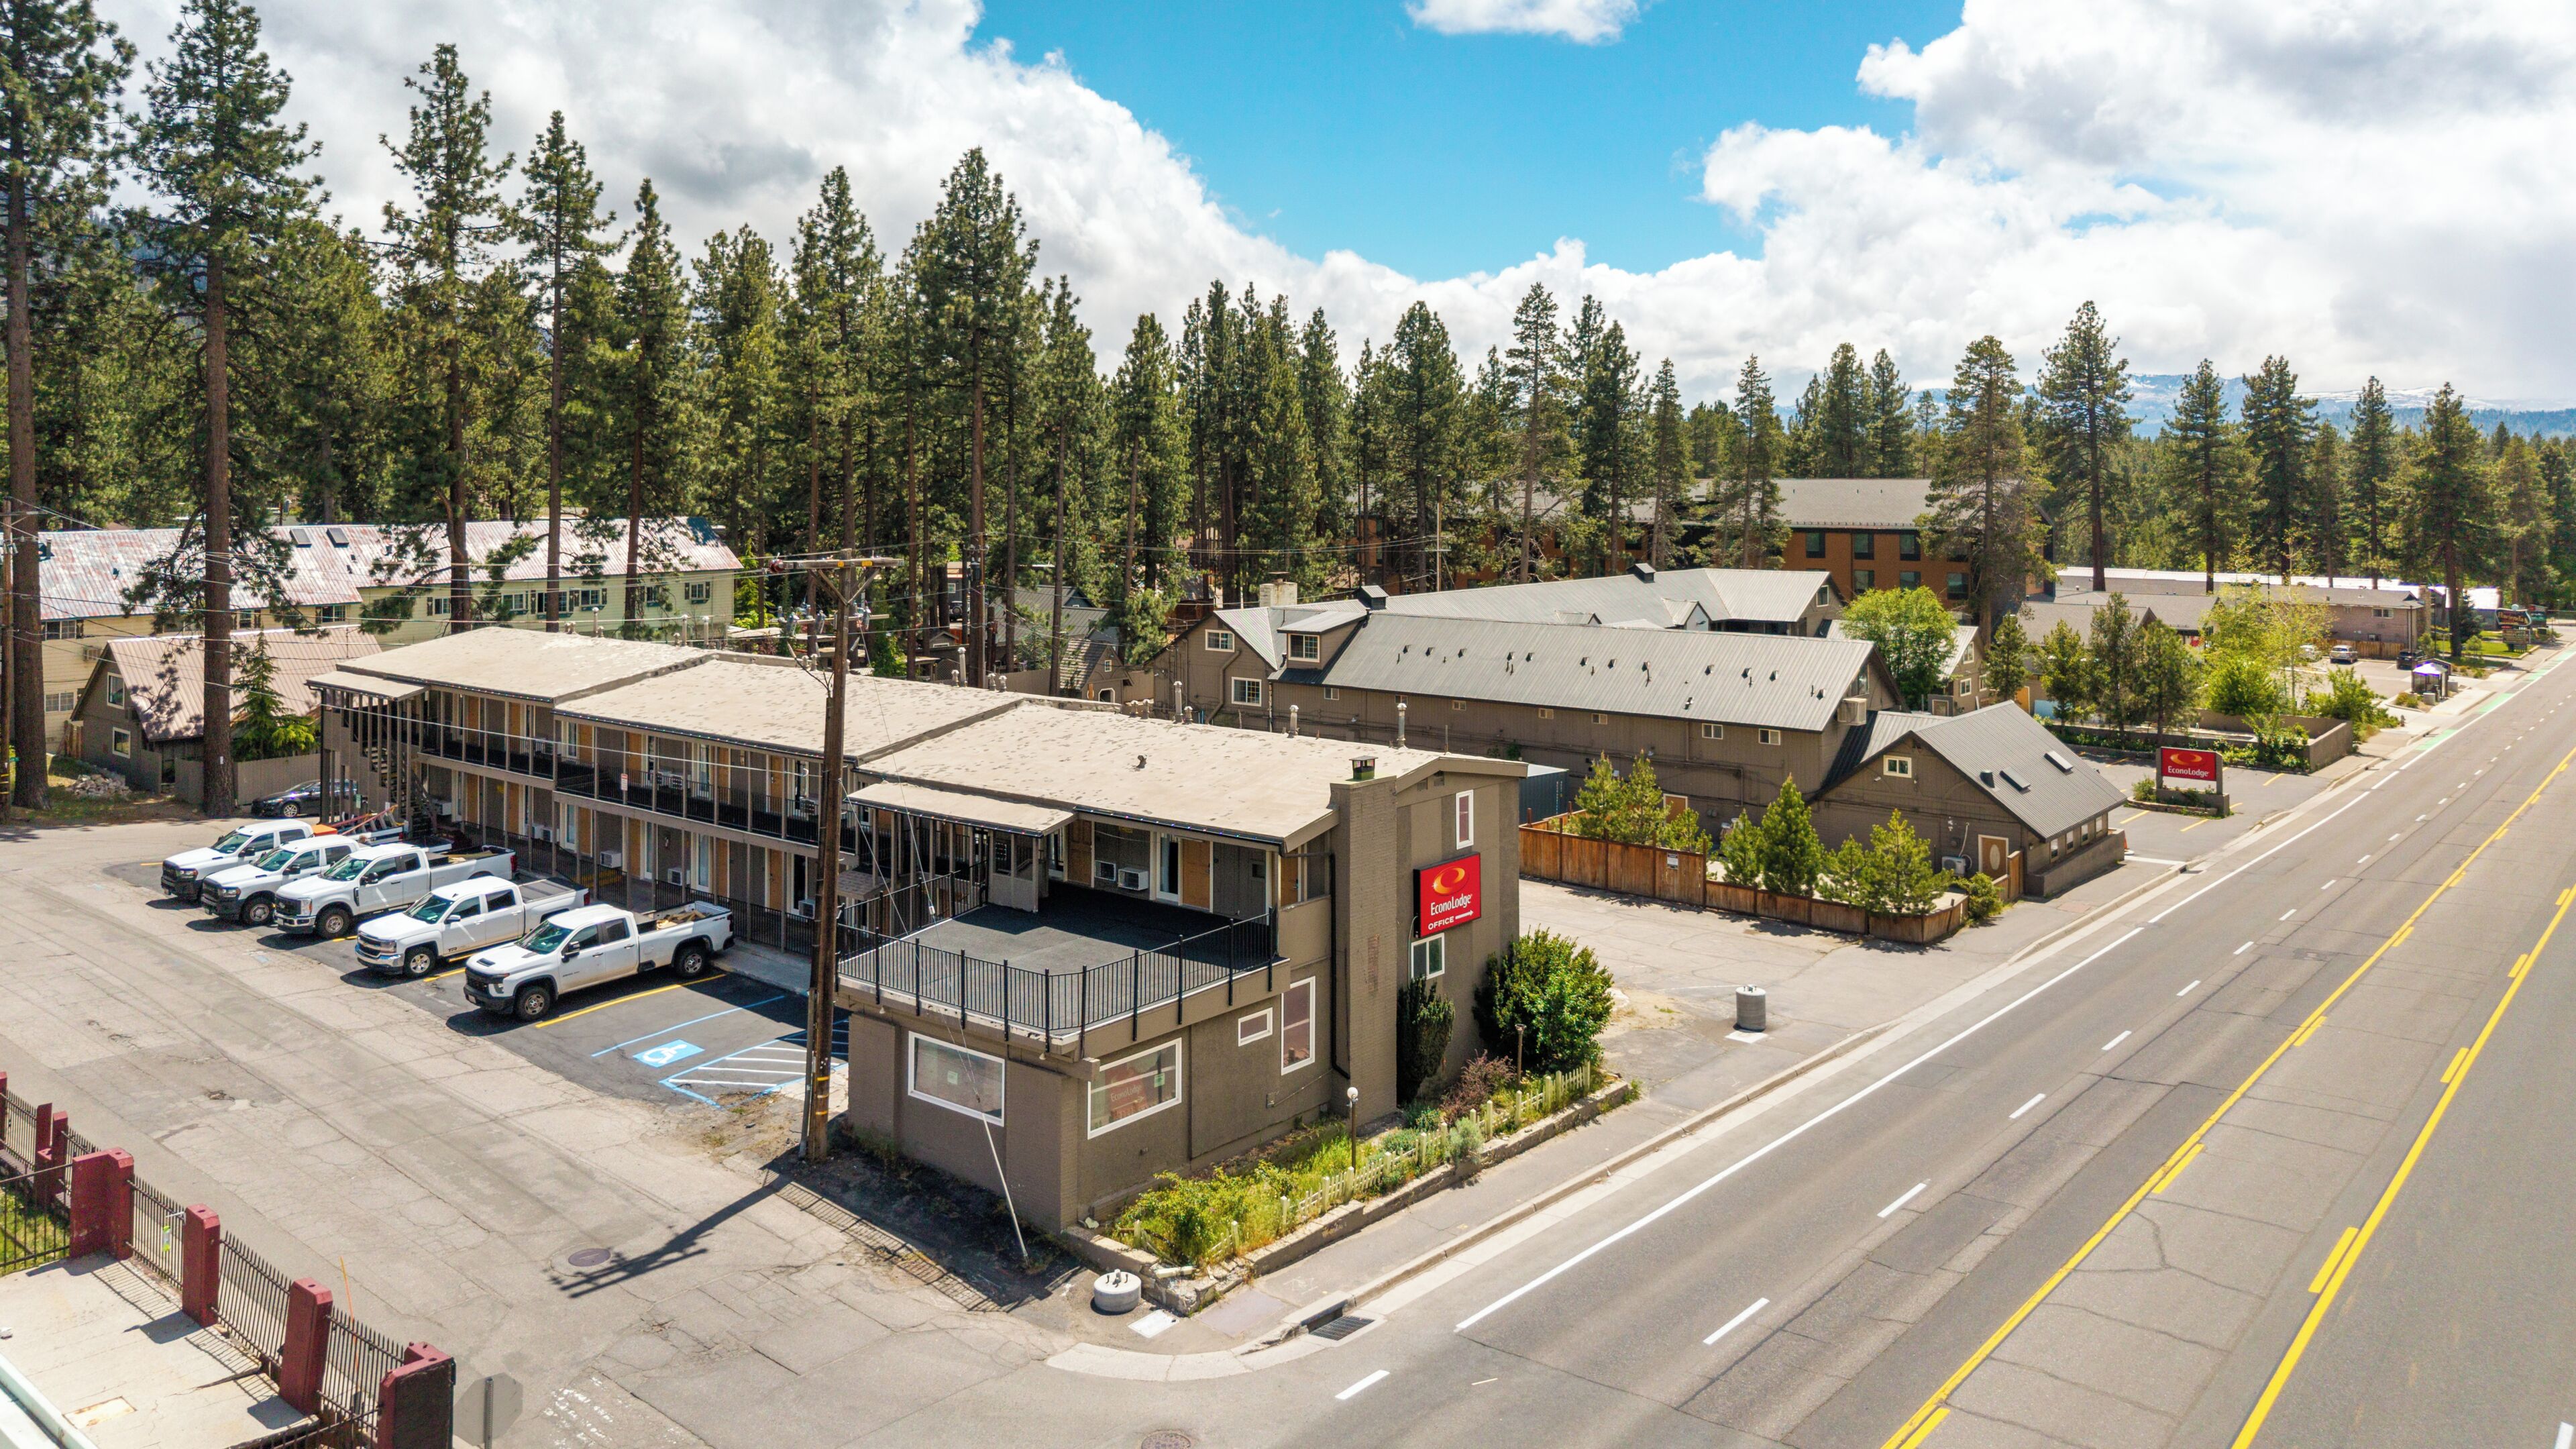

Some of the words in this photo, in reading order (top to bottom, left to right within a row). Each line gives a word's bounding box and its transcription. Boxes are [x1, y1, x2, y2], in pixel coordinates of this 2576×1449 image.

[2167, 765, 2208, 777] EconoLodge
[1430, 893, 1472, 916] EconoLodge
[1428, 916, 1454, 930] OFFICE
[1111, 1084, 1142, 1102] EconoLodge
